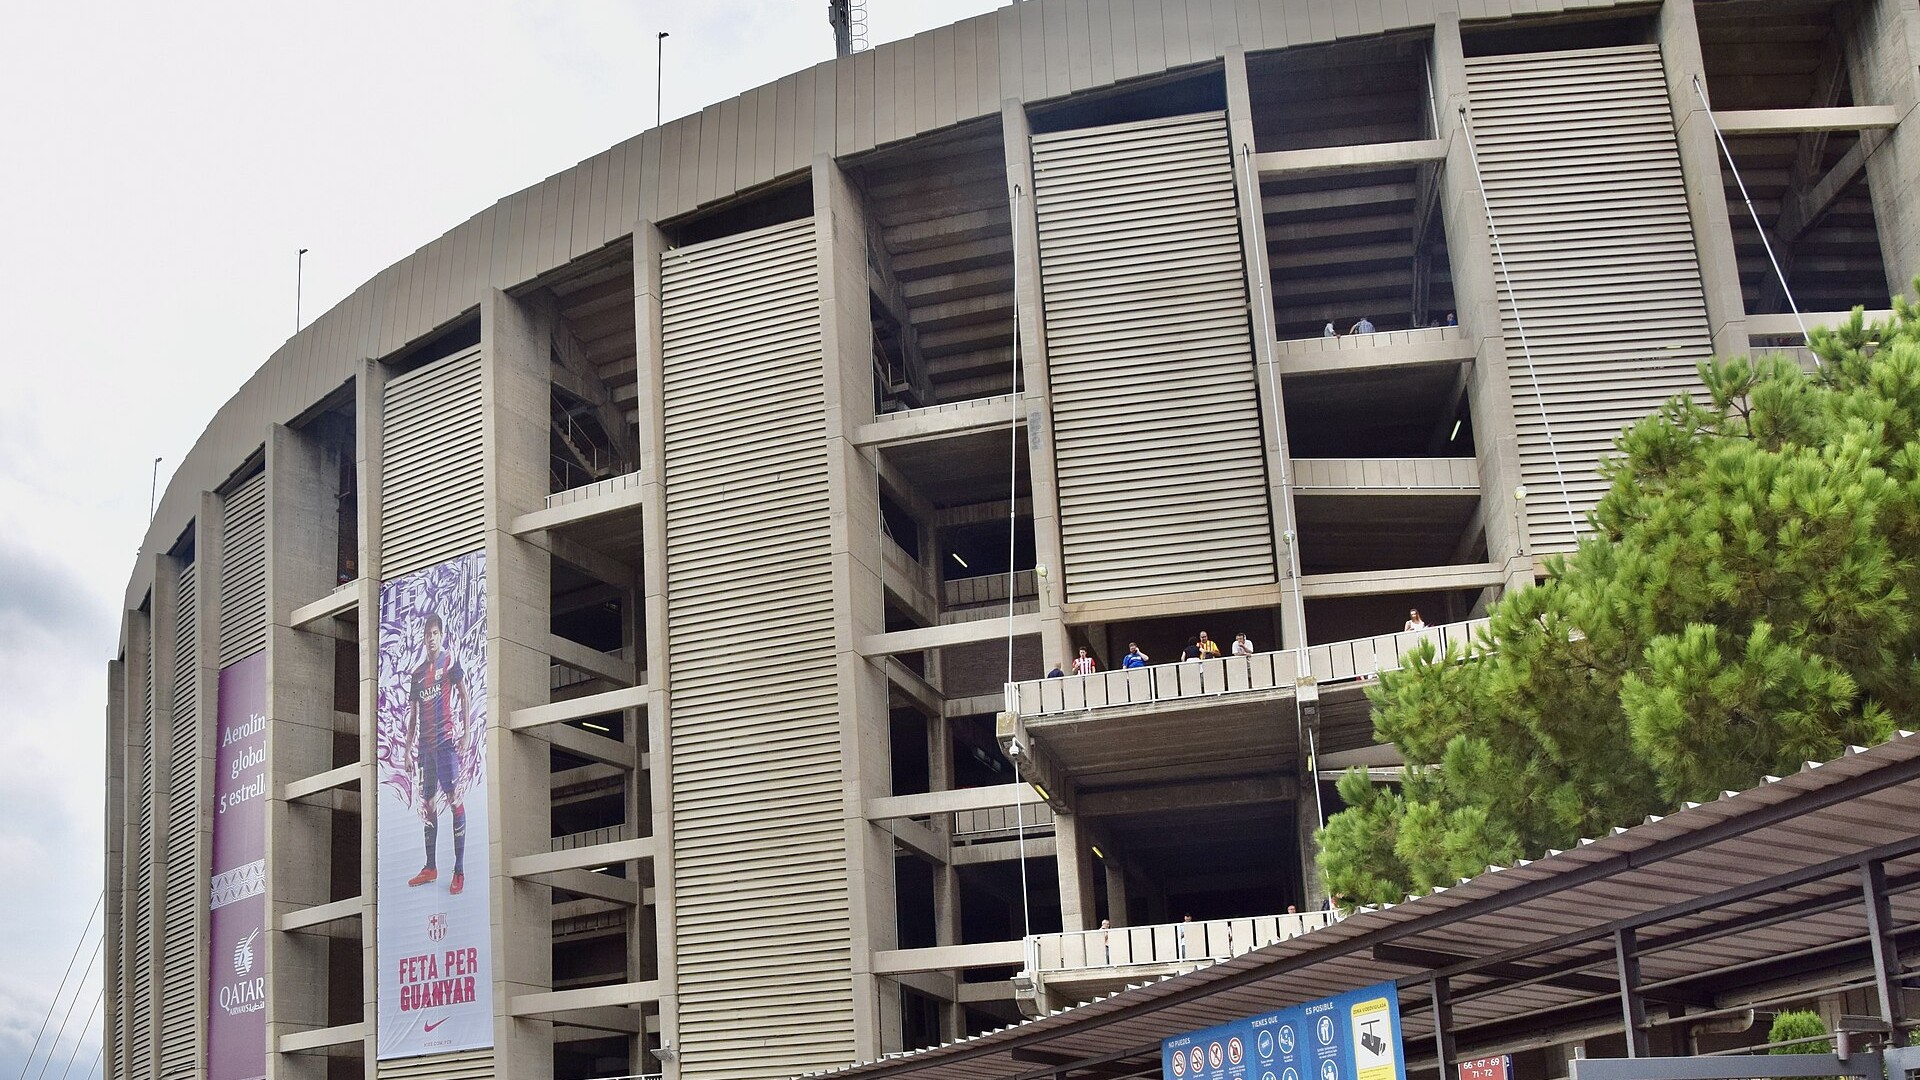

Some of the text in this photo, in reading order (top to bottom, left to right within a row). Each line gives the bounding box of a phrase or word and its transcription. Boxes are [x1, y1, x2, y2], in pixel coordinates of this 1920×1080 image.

[419, 684, 442, 699] QATAR
[222, 713, 266, 748] Aerolín
[231, 740, 266, 780] global
[219, 773, 266, 814] 5 estrell
[399, 947, 478, 984] FETA PER
[220, 977, 265, 1012] QATAR
[400, 976, 476, 1012] GUANYAR
[1268, 1015, 1278, 1024] QUE
[1305, 1001, 1334, 1015] ES POSIBLE
[1168, 1040, 1175, 1048] NO
[1463, 1061, 1473, 1070] 66
[1477, 1060, 1485, 1068] 67
[1490, 1058, 1500, 1066] 69
[1472, 1070, 1479, 1078] 71
[1484, 1069, 1493, 1077] 72
